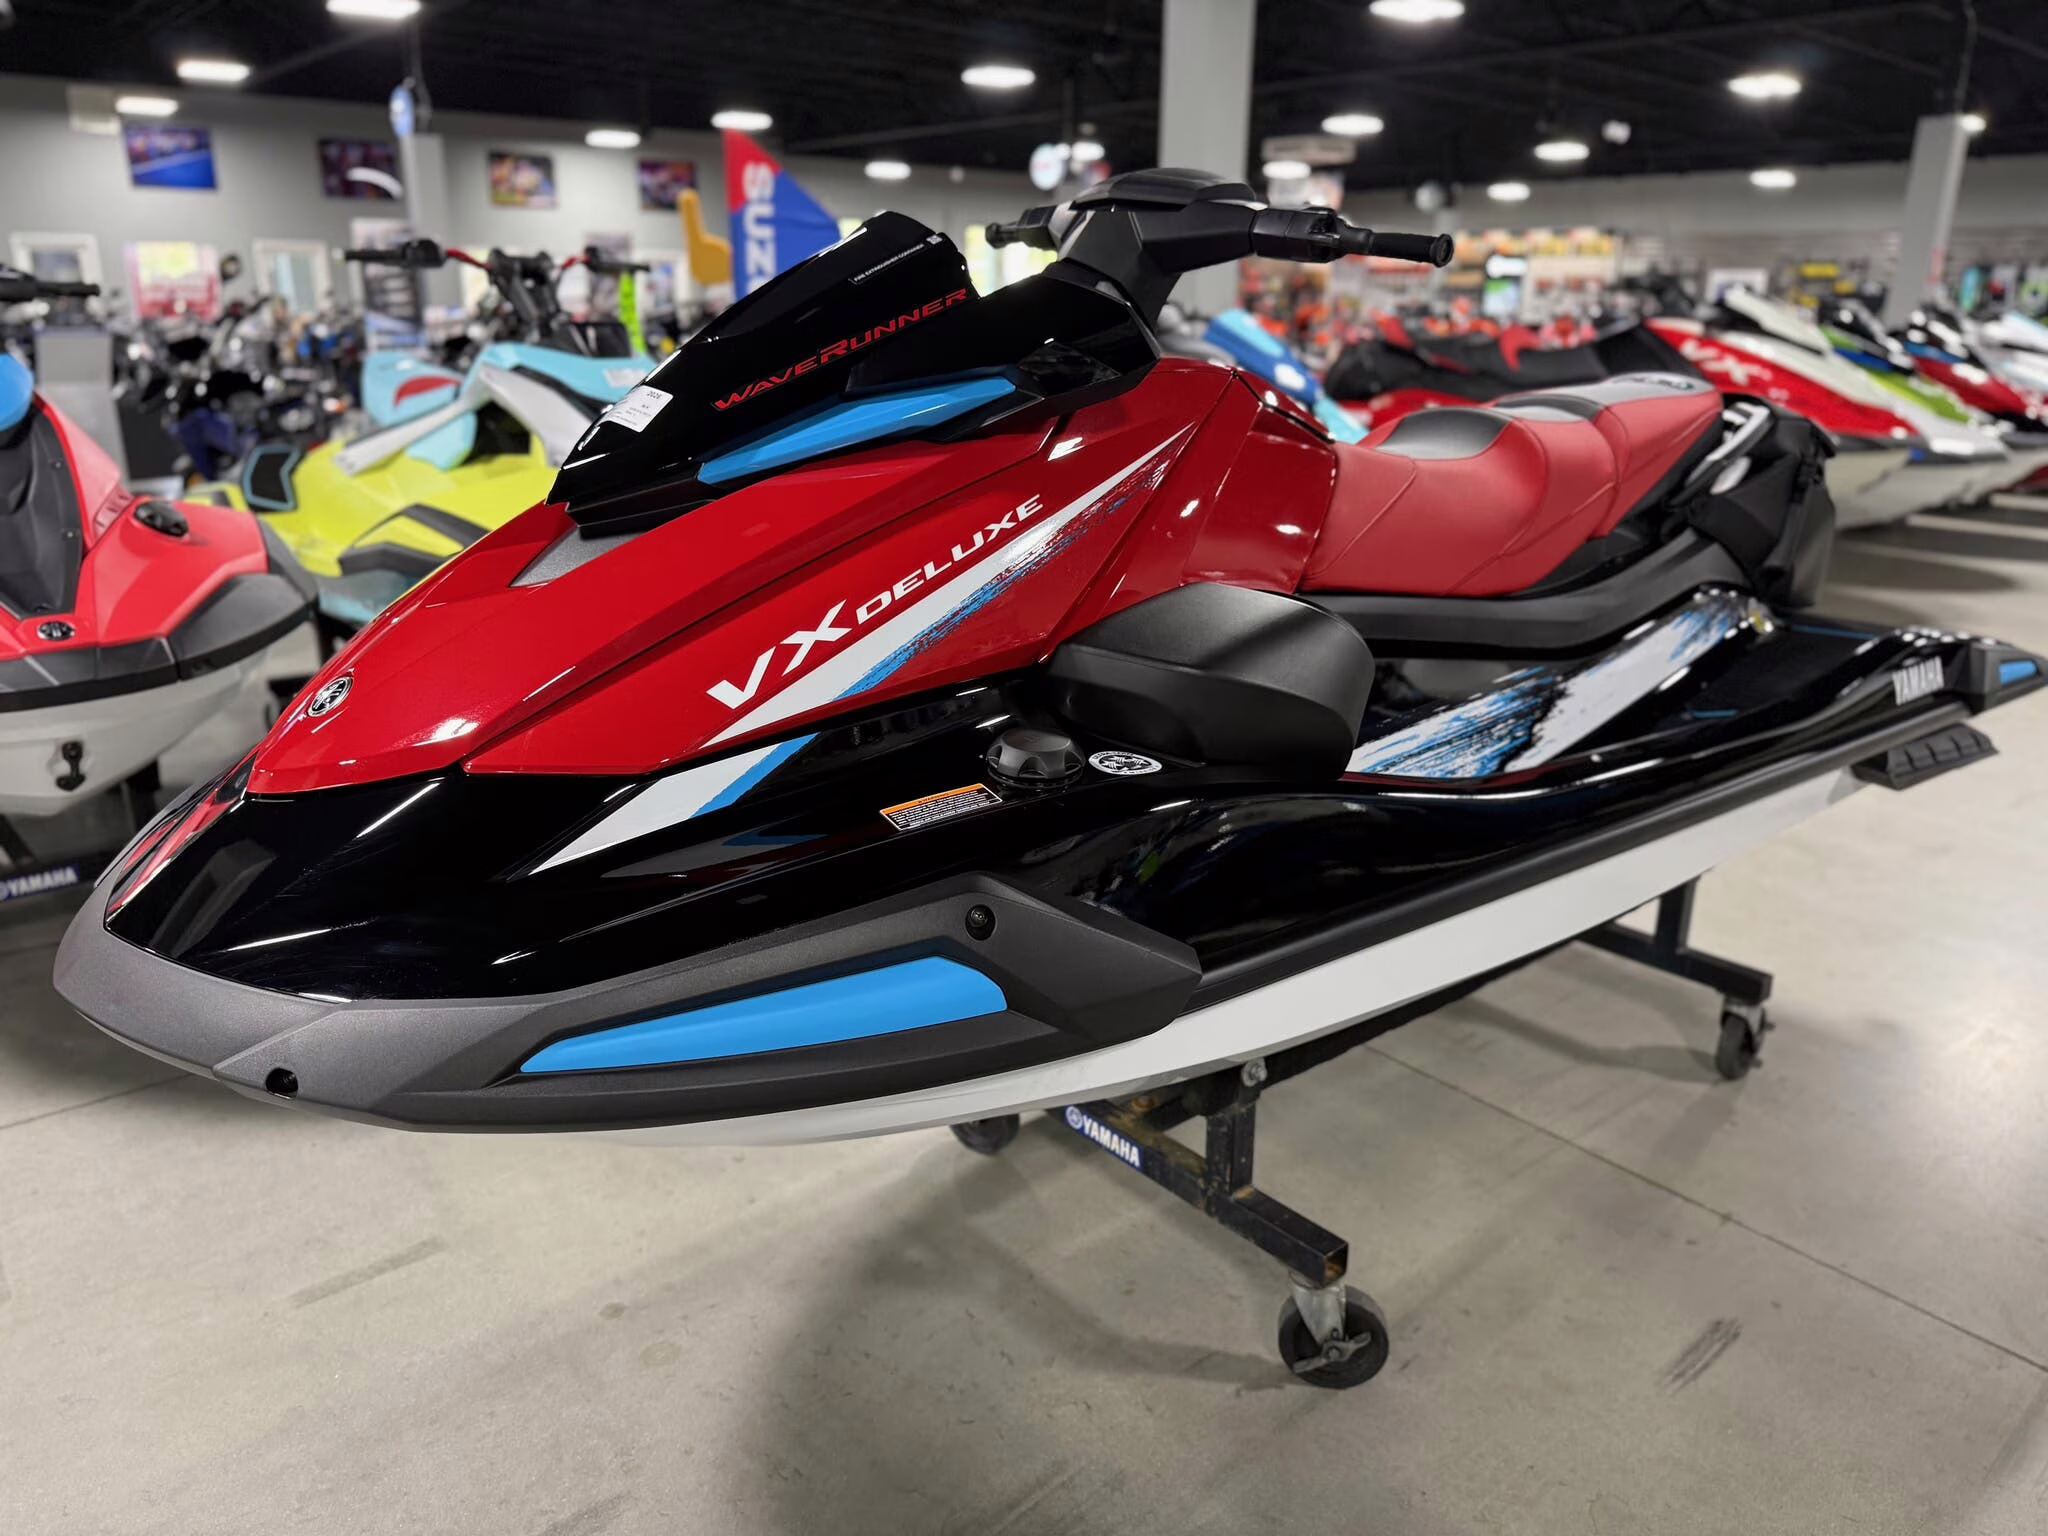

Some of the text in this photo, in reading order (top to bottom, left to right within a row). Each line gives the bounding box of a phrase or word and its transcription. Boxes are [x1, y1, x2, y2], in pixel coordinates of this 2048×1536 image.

[742, 160, 777, 294] SUZ
[713, 287, 968, 411] WAVERUNNER
[705, 493, 1044, 710] VX DELUXE
[1892, 656, 1944, 706] YAMAHA
[7, 866, 78, 897] YAMAHA
[1083, 1114, 1140, 1168] YAMAHA
